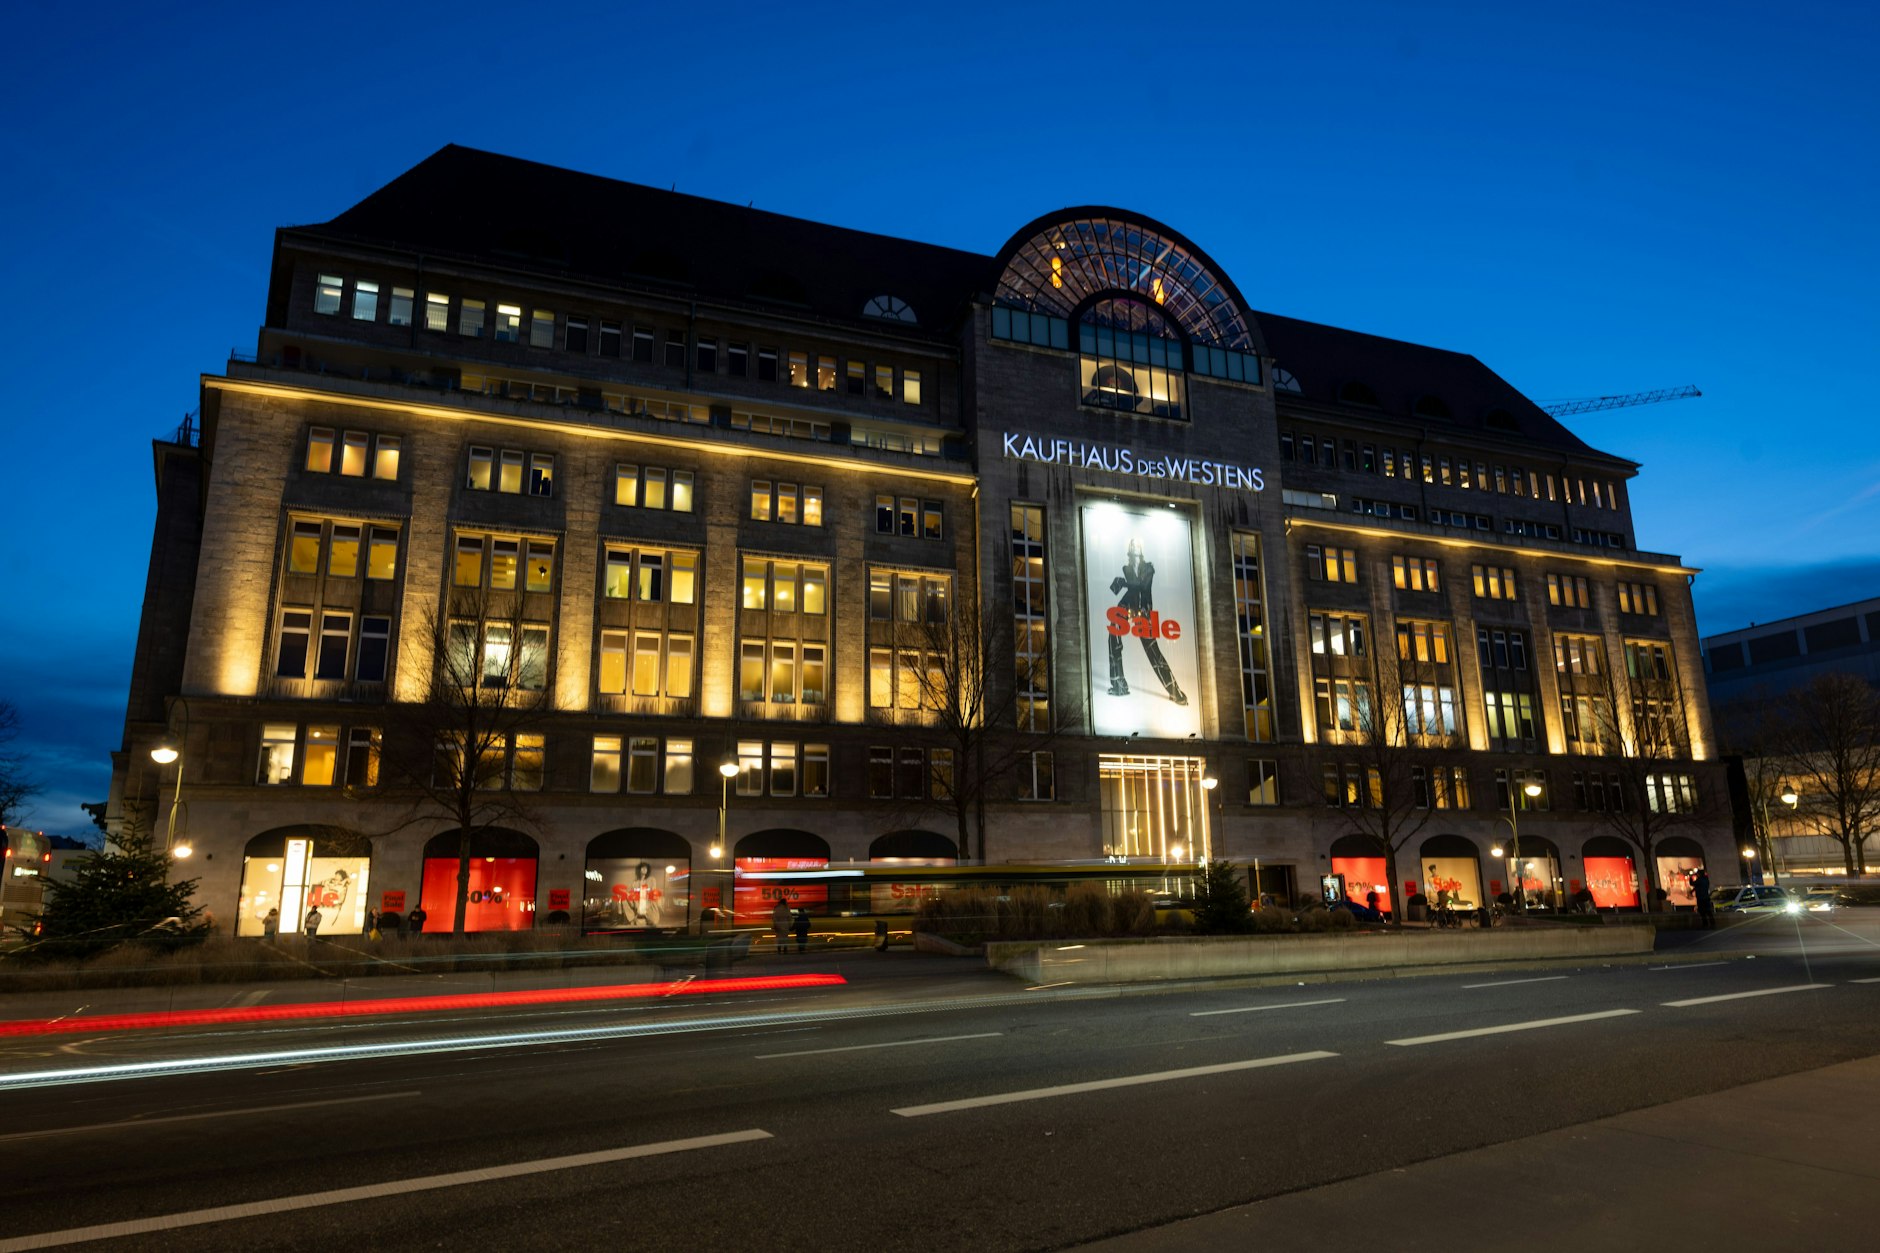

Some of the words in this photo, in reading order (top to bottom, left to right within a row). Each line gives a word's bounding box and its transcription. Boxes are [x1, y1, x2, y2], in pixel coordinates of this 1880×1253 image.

[1003, 432, 1133, 475] KAUFHAUS
[1137, 459, 1166, 479] DES
[1165, 456, 1265, 491] WESTENS
[1105, 605, 1182, 640] Sale
[761, 887, 800, 901] 50%
